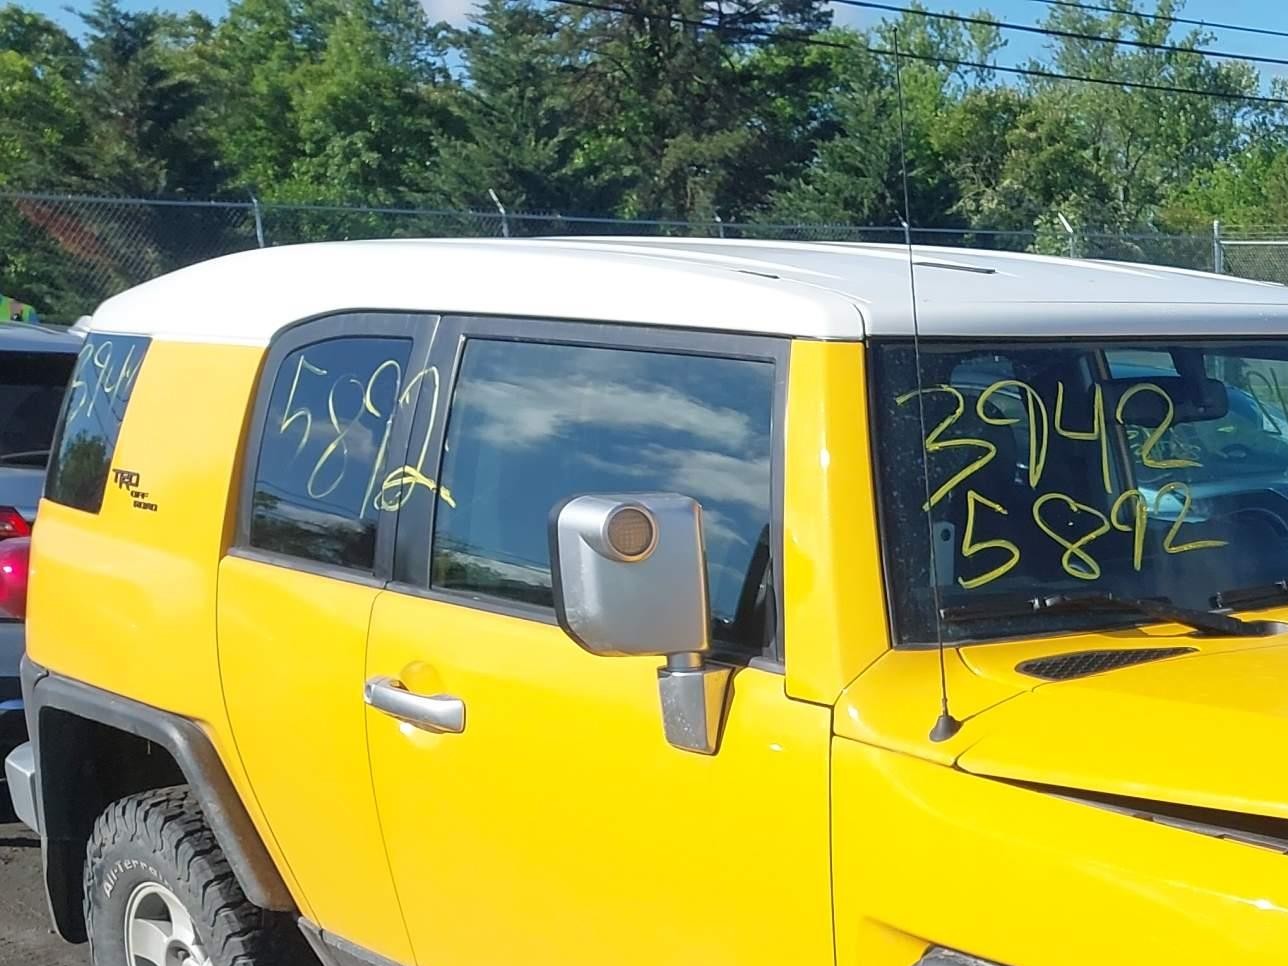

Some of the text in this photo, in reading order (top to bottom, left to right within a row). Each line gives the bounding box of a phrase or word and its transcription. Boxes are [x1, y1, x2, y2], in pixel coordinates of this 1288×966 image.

[112, 468, 140, 491] TRD
[280, 355, 456, 519] 5892
[896, 379, 1204, 512] 3942
[957, 481, 1230, 590] 5892
